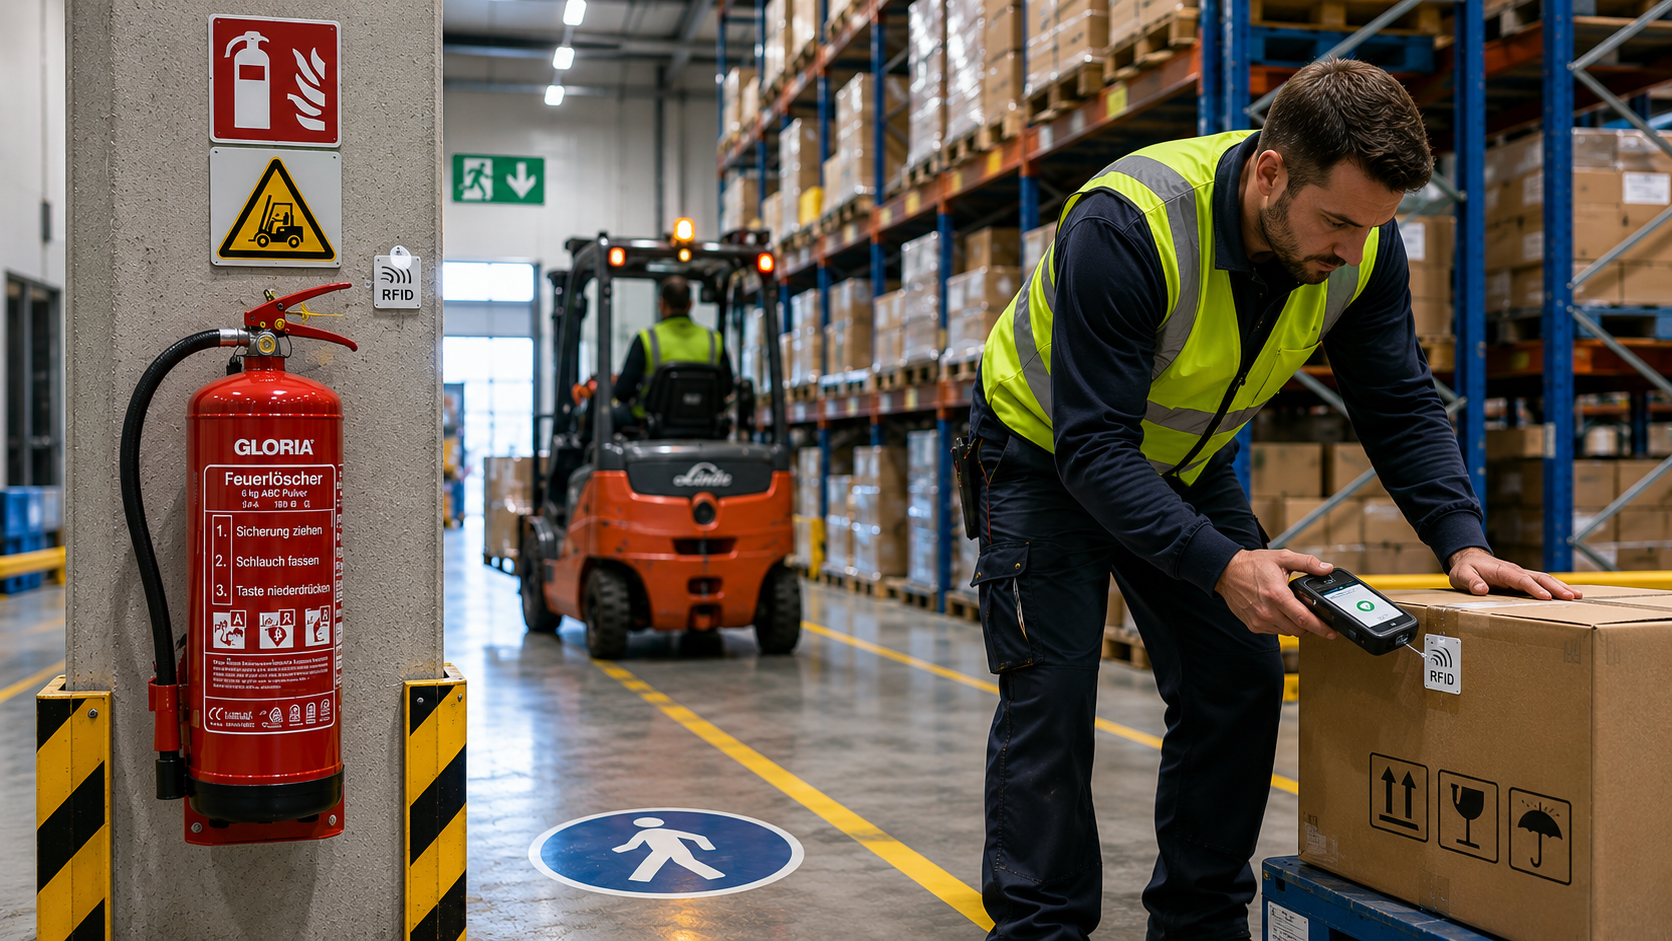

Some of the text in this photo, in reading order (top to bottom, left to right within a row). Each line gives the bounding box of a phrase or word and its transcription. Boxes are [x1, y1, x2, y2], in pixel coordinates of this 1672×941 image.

[382, 289, 414, 301] RFID
[234, 438, 314, 456] GLORIA
[225, 471, 323, 486] Feuerlöscher
[261, 488, 281, 498] ABC
[216, 524, 323, 539] 1. Sicherung ziehen
[215, 554, 320, 568] 2. Schlauch fassen
[216, 583, 331, 597] 3. Taste niederdrücken
[1430, 670, 1455, 686] RFID
